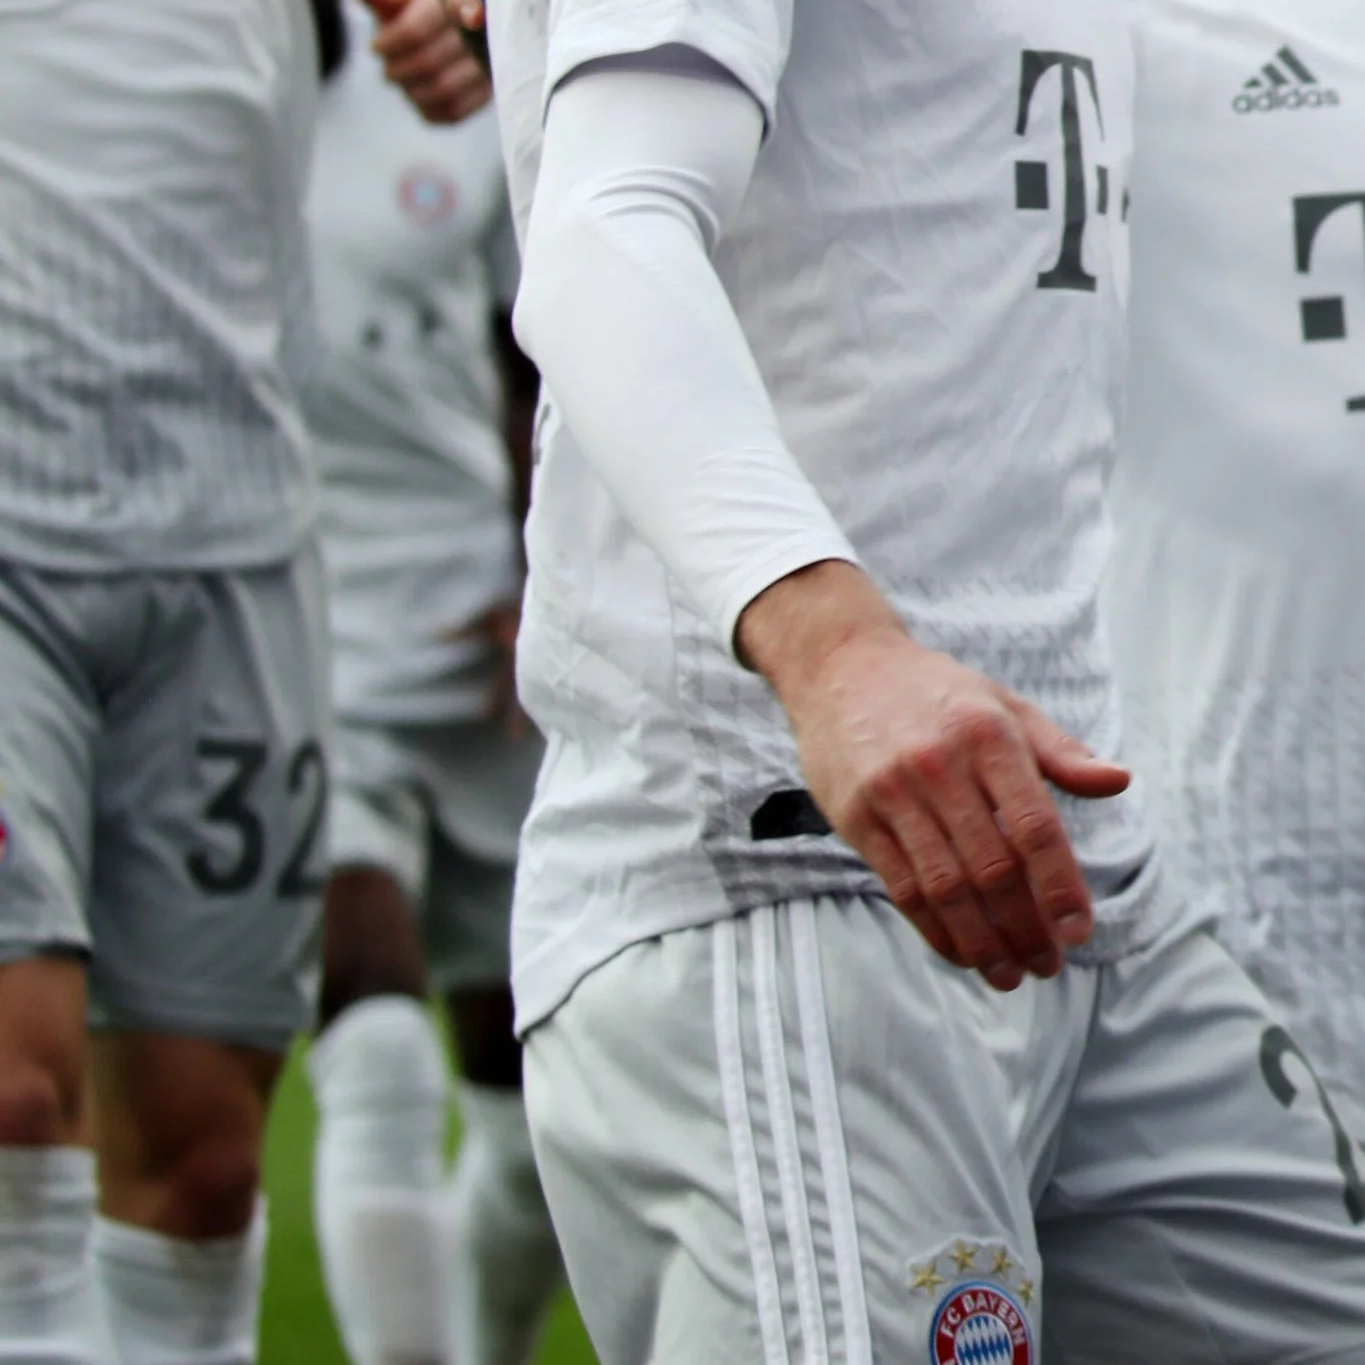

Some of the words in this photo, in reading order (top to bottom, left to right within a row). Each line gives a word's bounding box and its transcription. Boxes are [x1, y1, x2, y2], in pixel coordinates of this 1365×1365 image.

[1231, 87, 1341, 114] adidas
[186, 737, 327, 901] 32
[940, 1306, 961, 1338] FC
